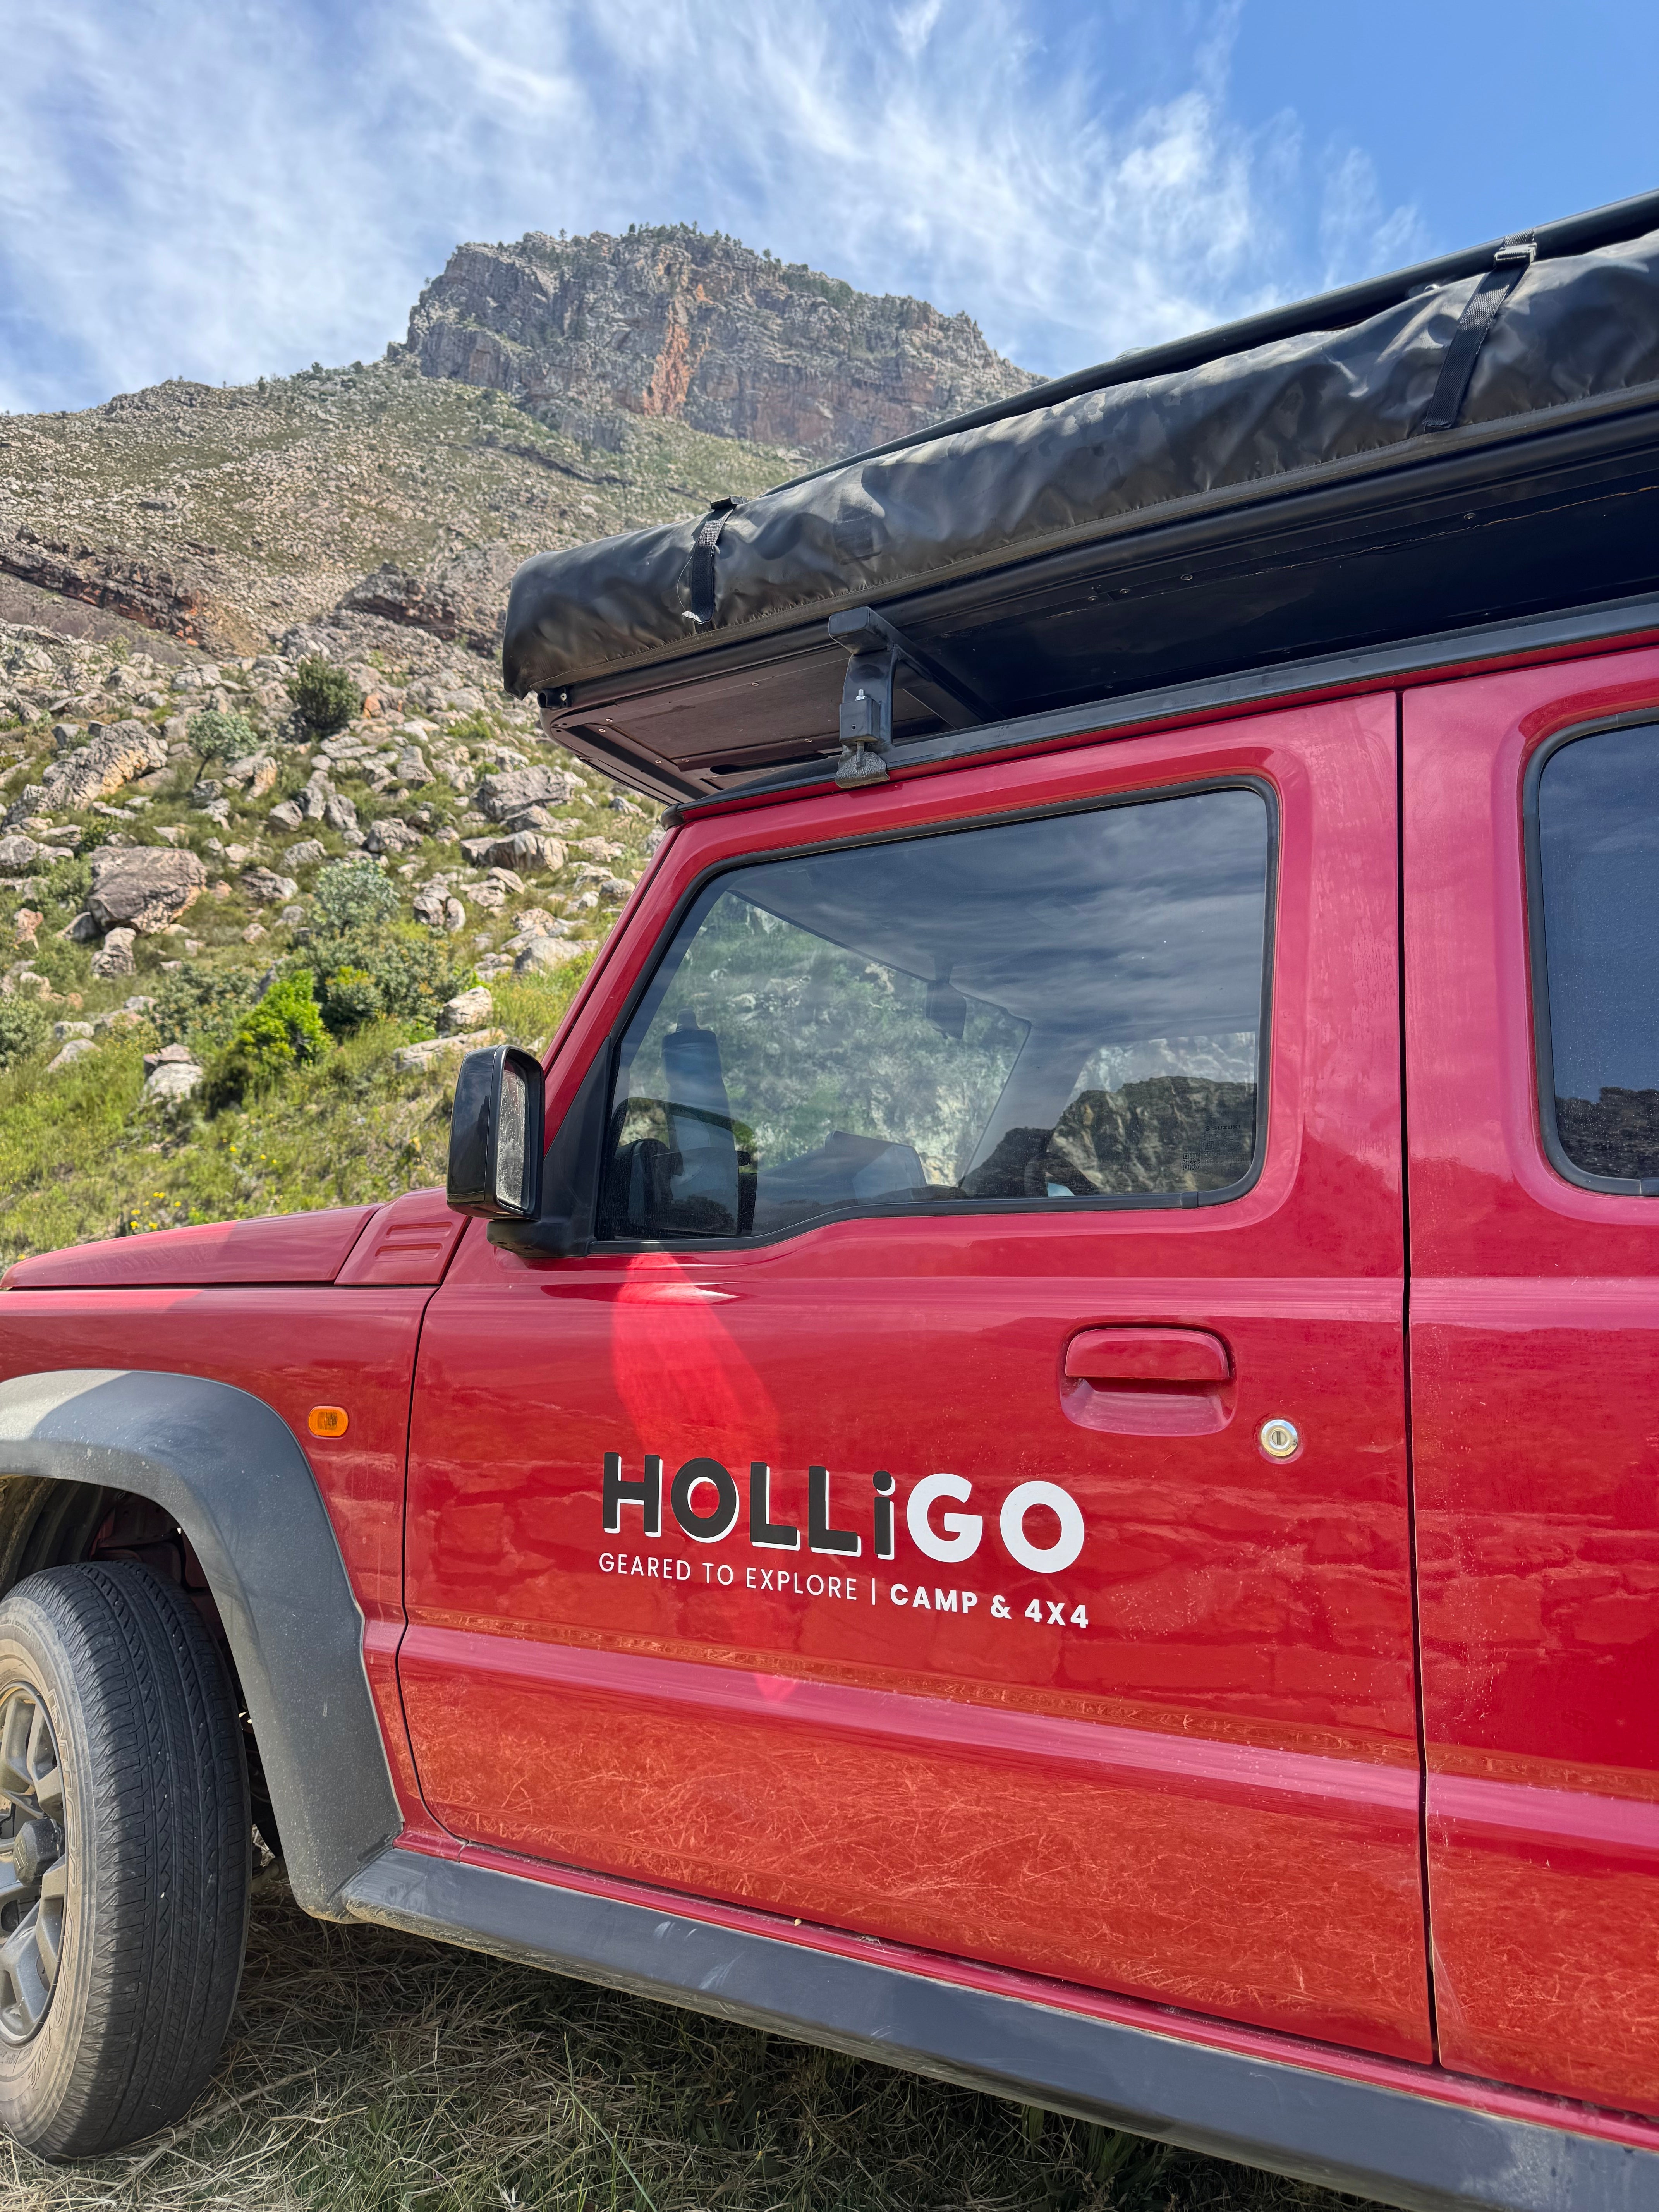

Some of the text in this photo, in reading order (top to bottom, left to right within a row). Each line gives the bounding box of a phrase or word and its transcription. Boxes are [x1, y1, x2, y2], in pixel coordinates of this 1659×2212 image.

[599, 1552, 691, 1580] GEARED
[702, 1562, 734, 1586] TO
[747, 1567, 857, 1601] EXPLORE
[890, 1583, 978, 1614] CAMP
[990, 1594, 1012, 1620] &
[1025, 1599, 1089, 1629] 4X4
